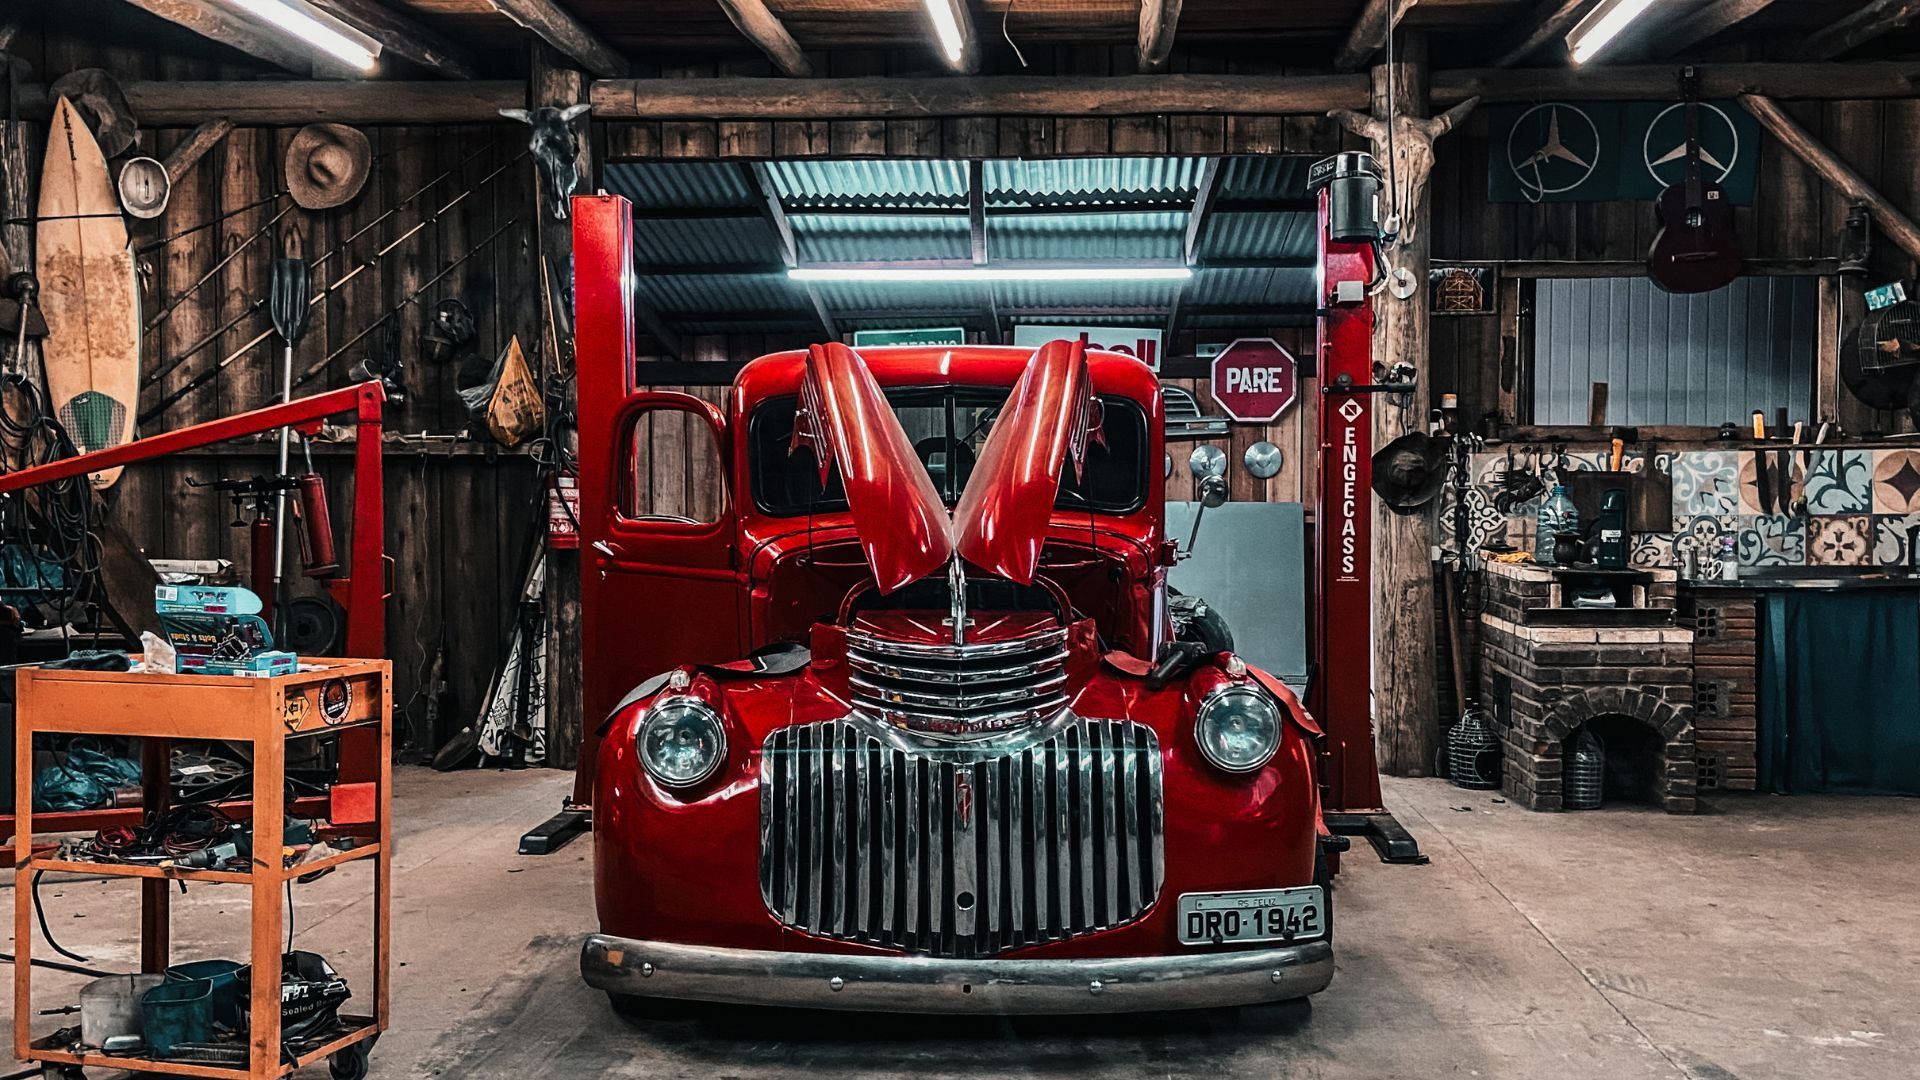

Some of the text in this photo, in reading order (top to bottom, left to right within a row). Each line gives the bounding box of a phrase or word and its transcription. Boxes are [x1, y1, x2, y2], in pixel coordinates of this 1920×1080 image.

[1226, 367, 1283, 393] PARE
[1342, 427, 1357, 573] ENGECASS
[1237, 898, 1277, 907] RS FELIZ
[282, 1003, 314, 1016] Sealed
